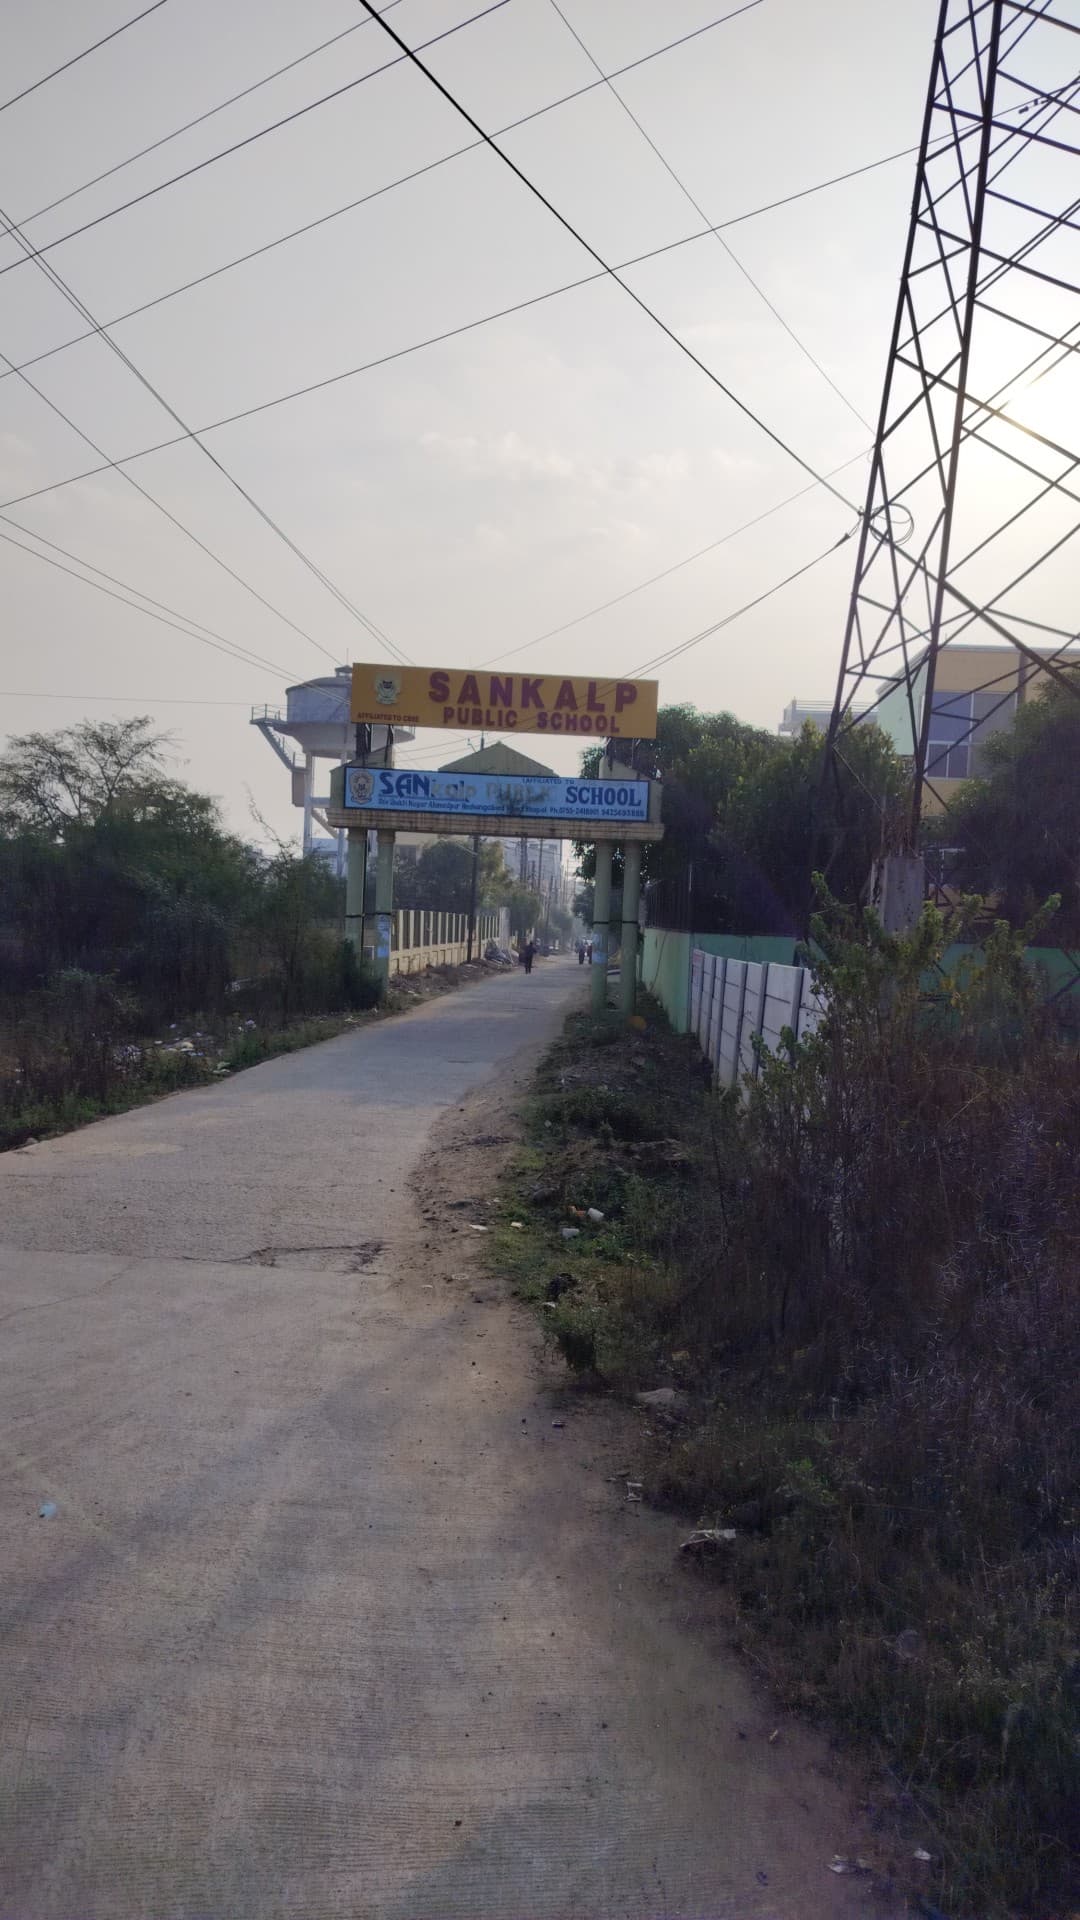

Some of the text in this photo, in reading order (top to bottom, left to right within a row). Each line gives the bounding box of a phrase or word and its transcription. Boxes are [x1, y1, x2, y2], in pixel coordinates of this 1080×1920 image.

[428, 671, 637, 713] SANKALP
[443, 706, 620, 733] PUBLIC SCHOOL
[565, 785, 642, 807] SCHOOL
